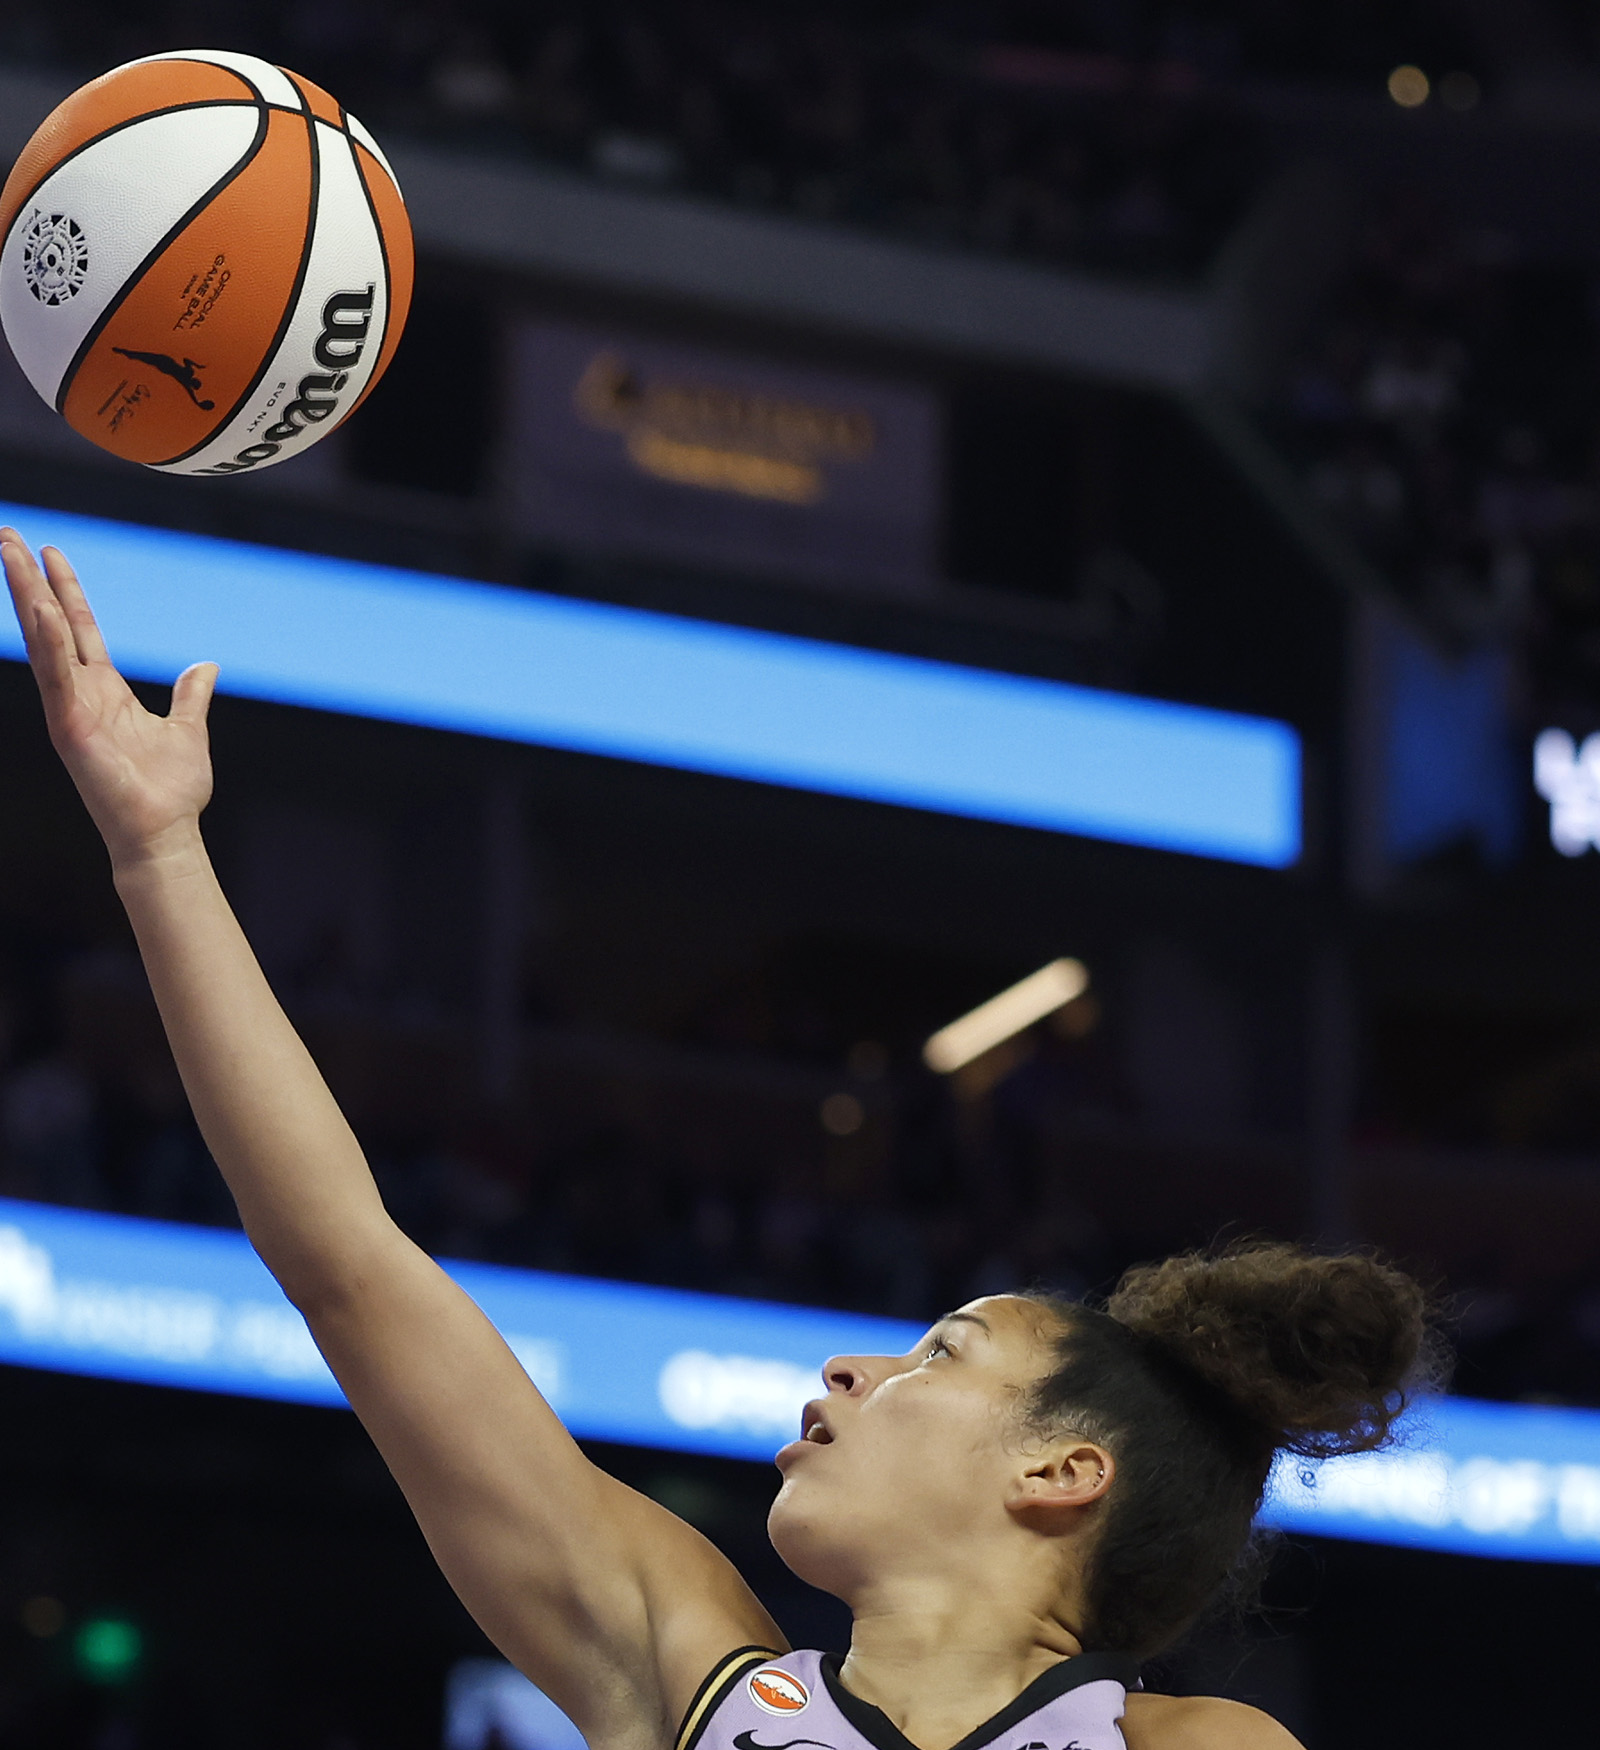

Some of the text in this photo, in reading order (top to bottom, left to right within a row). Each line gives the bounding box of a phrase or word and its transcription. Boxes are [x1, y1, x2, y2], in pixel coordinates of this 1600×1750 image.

[196, 254, 225, 297] GAME
[173, 298, 199, 332] BALL
[189, 270, 231, 329] OFFICIAL
[246, 382, 286, 433] EVO NXT
